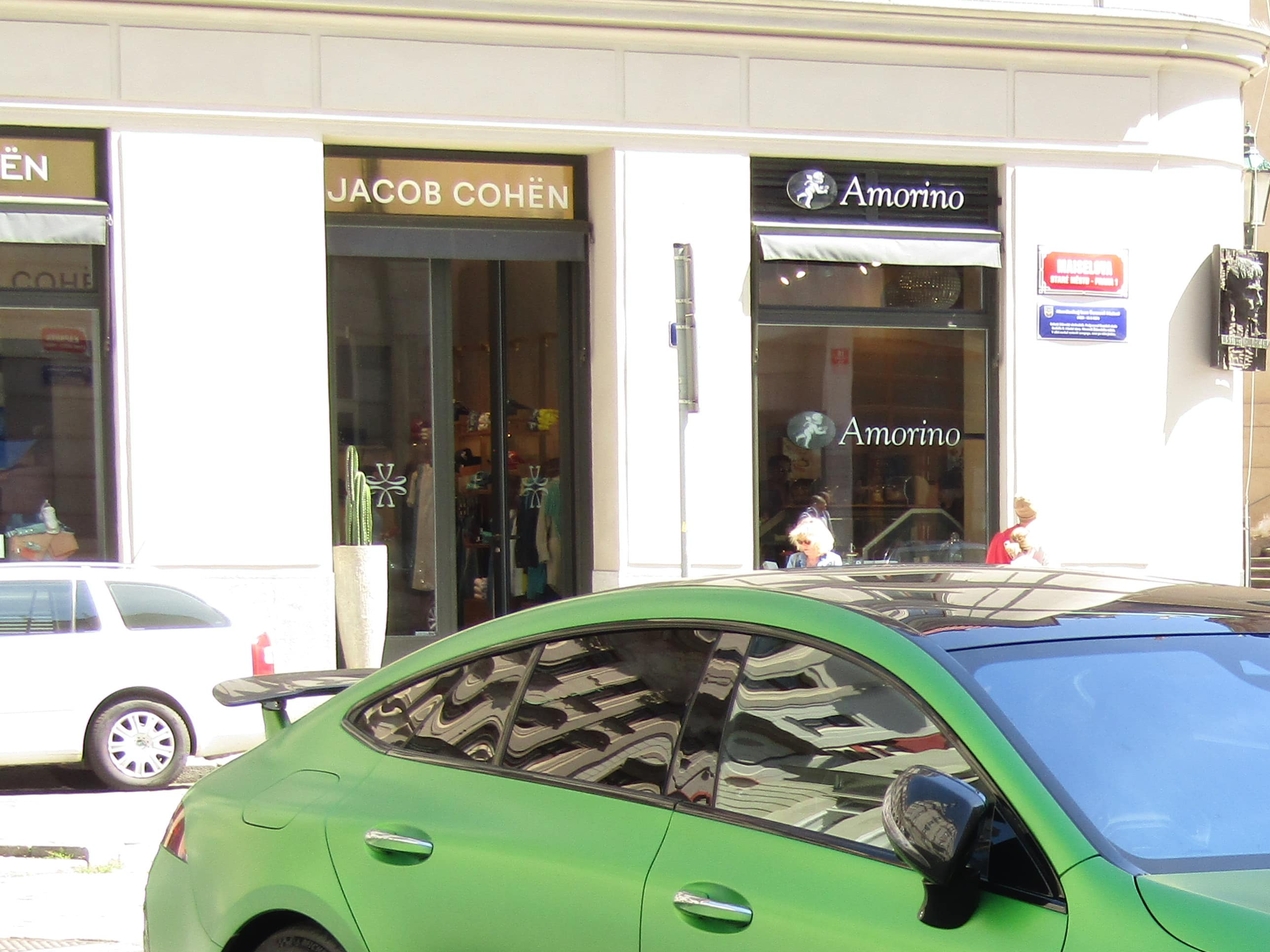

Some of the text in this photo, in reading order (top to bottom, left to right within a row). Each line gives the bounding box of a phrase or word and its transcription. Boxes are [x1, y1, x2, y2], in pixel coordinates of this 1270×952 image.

[328, 176, 568, 209] JACOB COHËN
[840, 175, 965, 210] Amorino
[839, 416, 961, 447] Amorino
